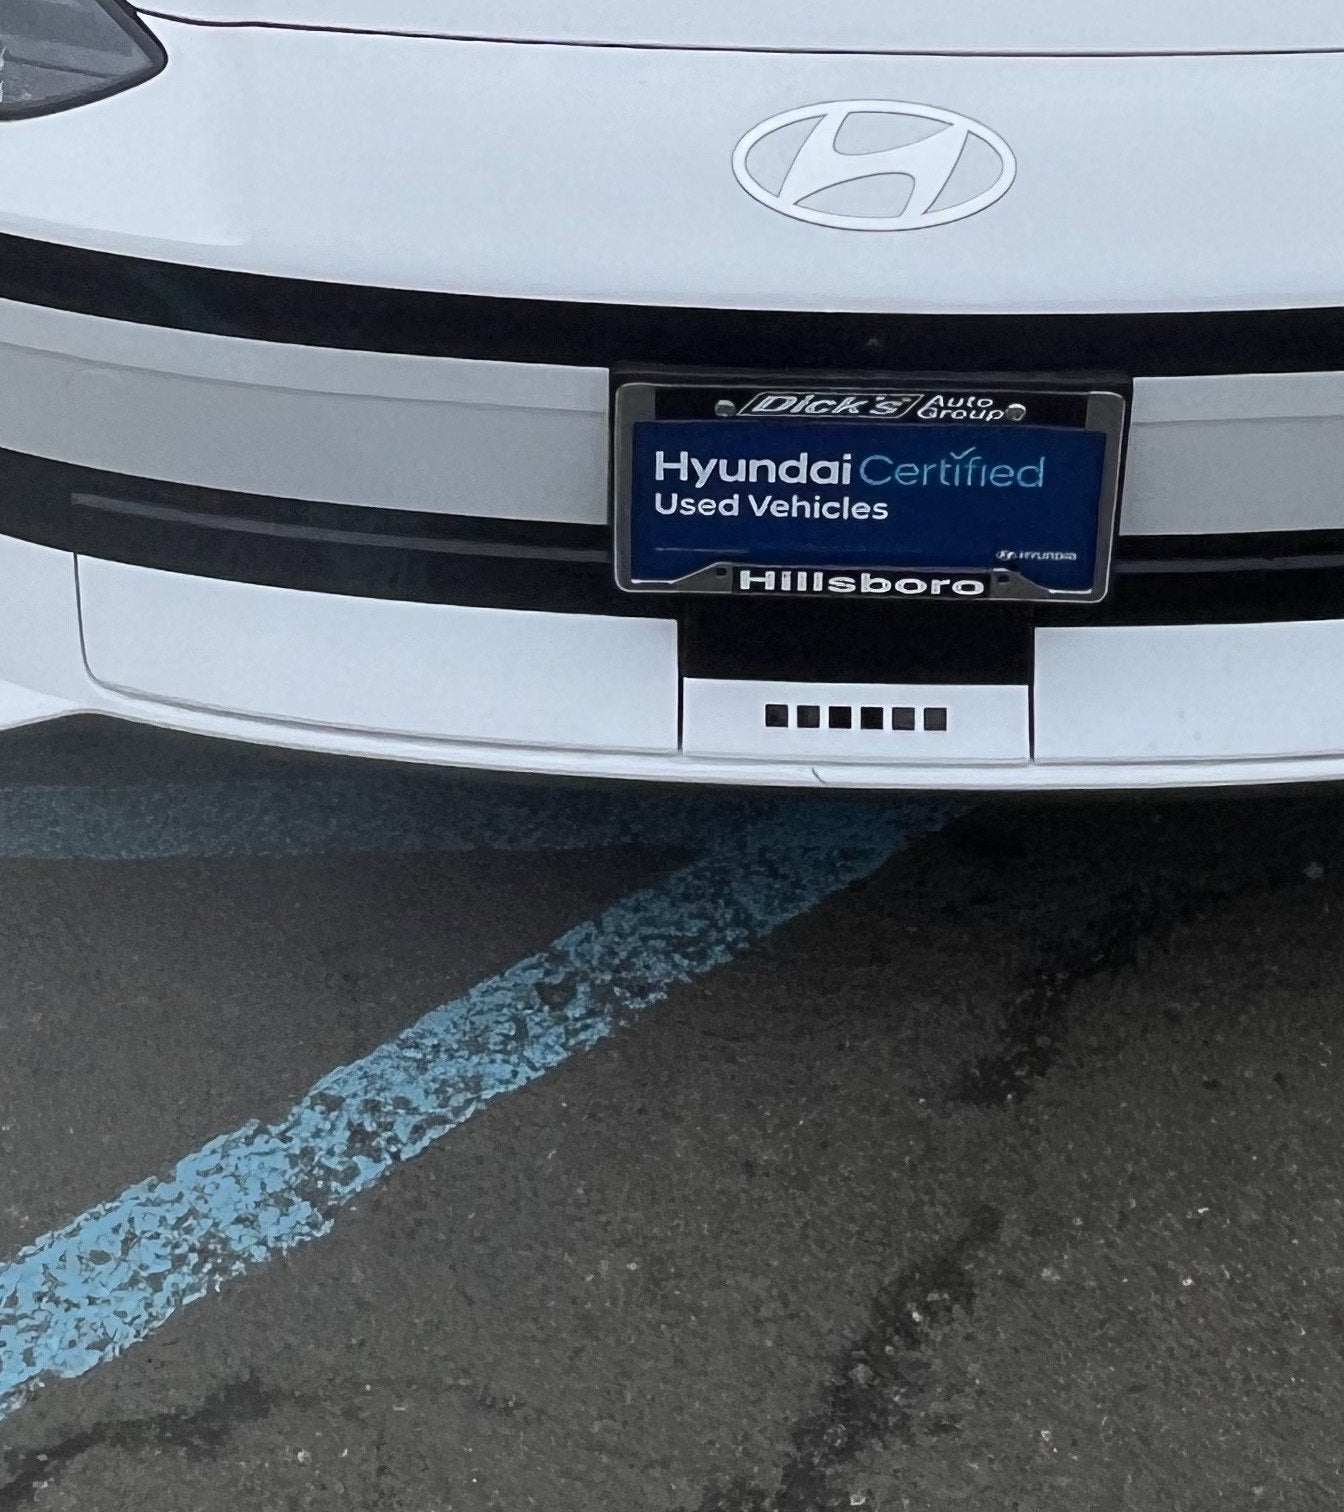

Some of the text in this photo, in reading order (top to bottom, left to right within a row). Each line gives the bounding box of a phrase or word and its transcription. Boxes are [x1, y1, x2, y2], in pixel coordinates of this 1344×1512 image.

[916, 404, 1006, 422] Group
[923, 394, 994, 408] Auto
[654, 446, 1045, 489] Hyundai Certified
[654, 492, 890, 520] Used Vehicles
[739, 568, 986, 597] Hillsboro
